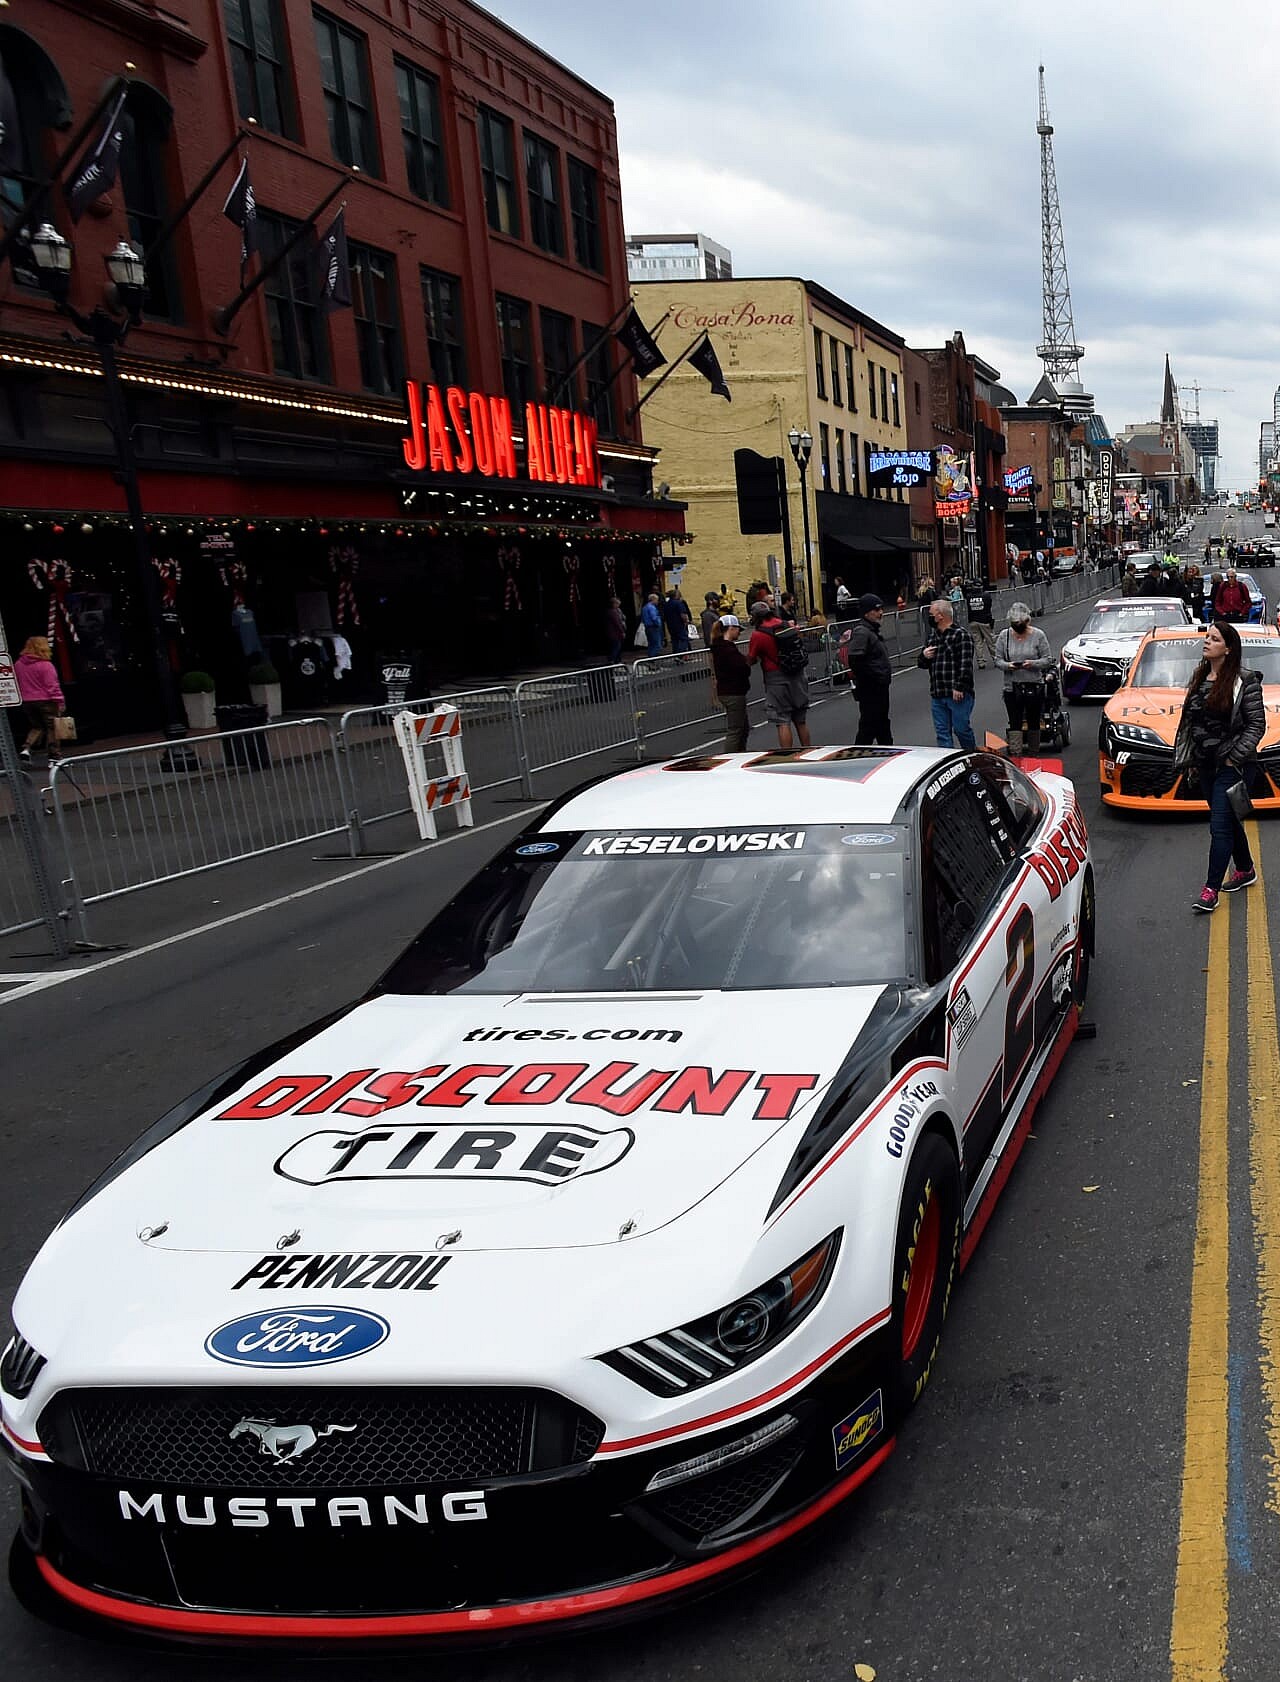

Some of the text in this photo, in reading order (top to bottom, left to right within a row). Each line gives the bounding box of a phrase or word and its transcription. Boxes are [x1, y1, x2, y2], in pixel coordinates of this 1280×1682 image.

[732, 301, 795, 327] Bona
[401, 380, 518, 479] JASON
[893, 474, 919, 486] MOJO
[1115, 750, 1131, 765] 18
[520, 842, 556, 855] Ford
[582, 830, 807, 857] KESELOWSKI
[851, 834, 887, 845] Ford
[461, 1025, 684, 1044] tires.com
[212, 1061, 821, 1122] DISCOUNT
[886, 1081, 938, 1159] GOODYEAR
[327, 1129, 601, 1177] TIRE
[231, 1254, 453, 1291] PENNZOIL
[237, 1309, 358, 1360] Ford
[837, 1408, 881, 1456] SUNOCO
[118, 1490, 489, 1529] MUSTANG
